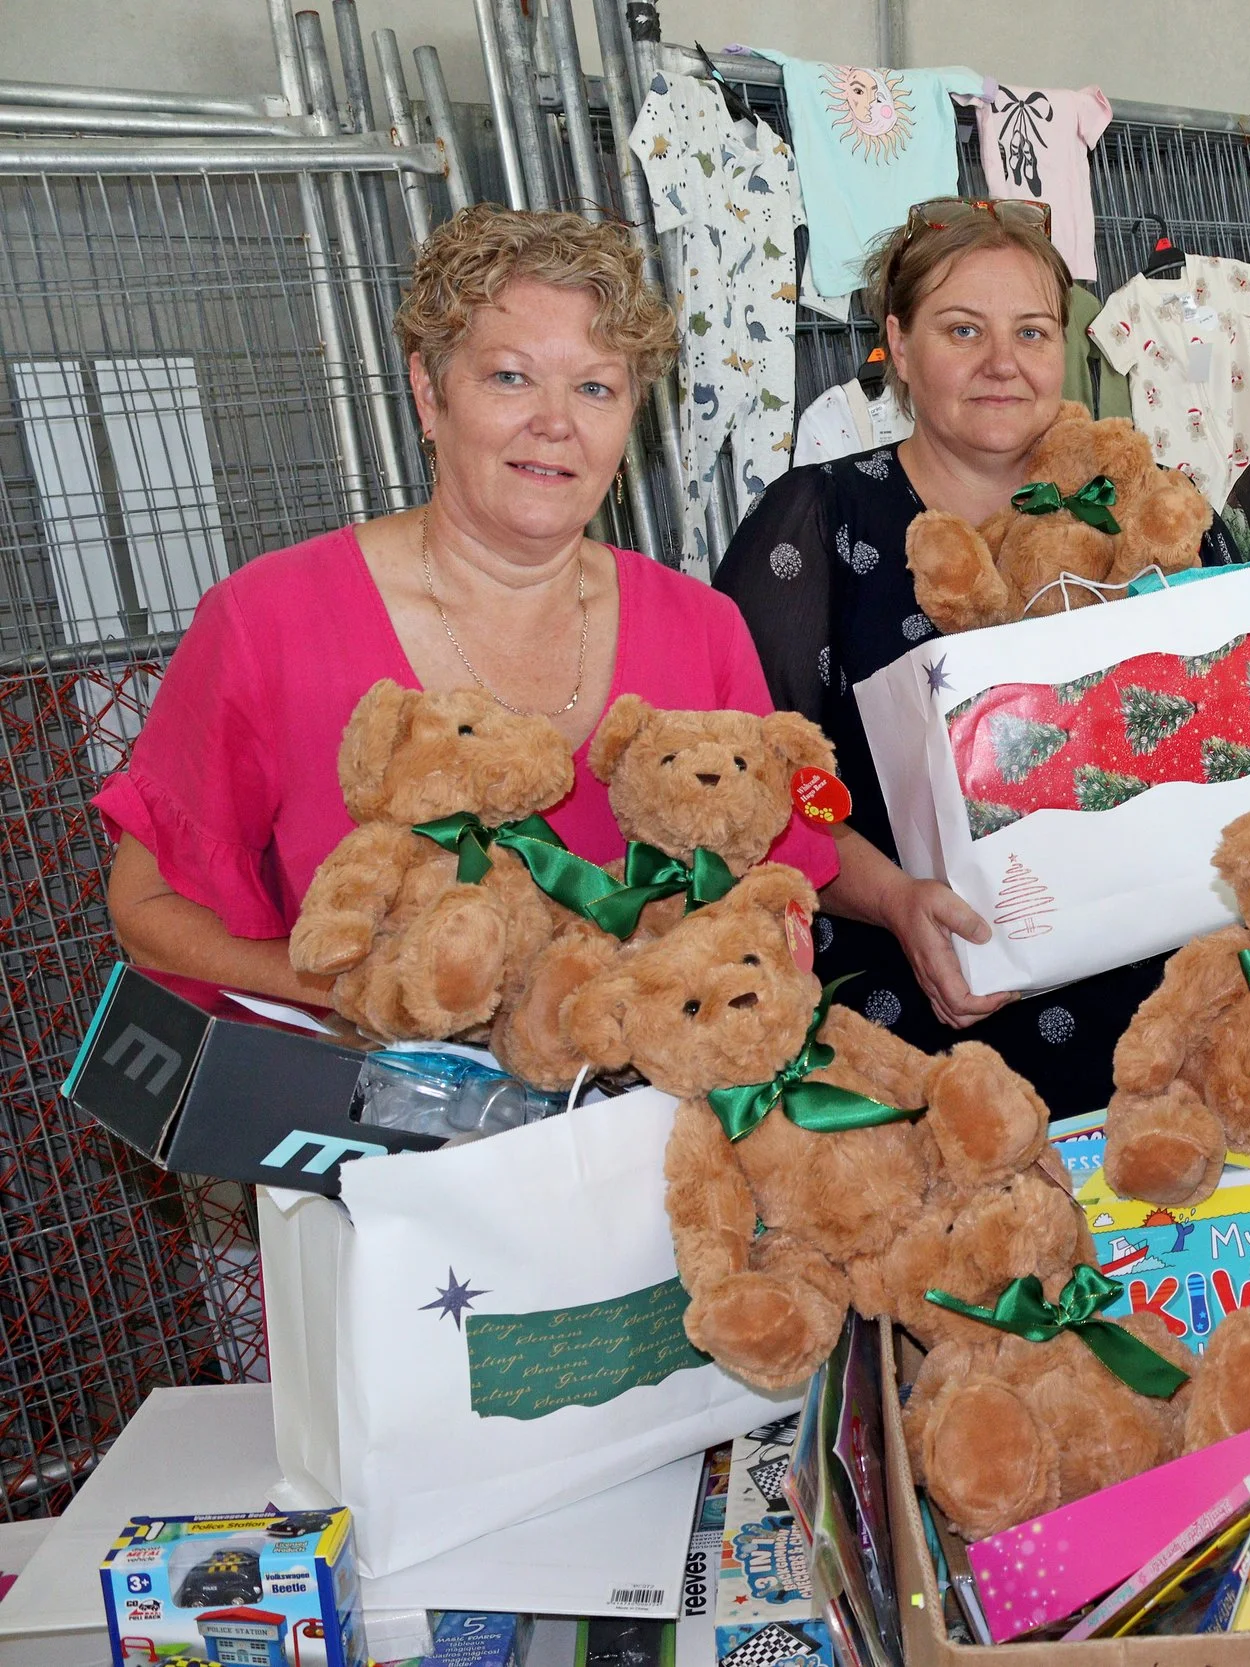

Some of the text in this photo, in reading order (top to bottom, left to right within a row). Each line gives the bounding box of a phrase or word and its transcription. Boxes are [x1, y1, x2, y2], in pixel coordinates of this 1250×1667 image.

[813, 779, 827, 791] Bear
[192, 1521, 265, 1531] Police Station
[750, 1550, 772, 1573] IN
[774, 1528, 799, 1592] BACKGAMMON
[129, 1575, 149, 1592] 3+
[265, 1572, 310, 1581] Volkswagen
[685, 1551, 707, 1616] reeves
[789, 1555, 813, 1599] CHECKERS
[271, 1582, 306, 1594] Beetle
[754, 1575, 778, 1597] 3
[207, 1626, 268, 1636] POLICE STATION
[462, 1616, 487, 1636] 5
[468, 1633, 502, 1641] BOARDS
